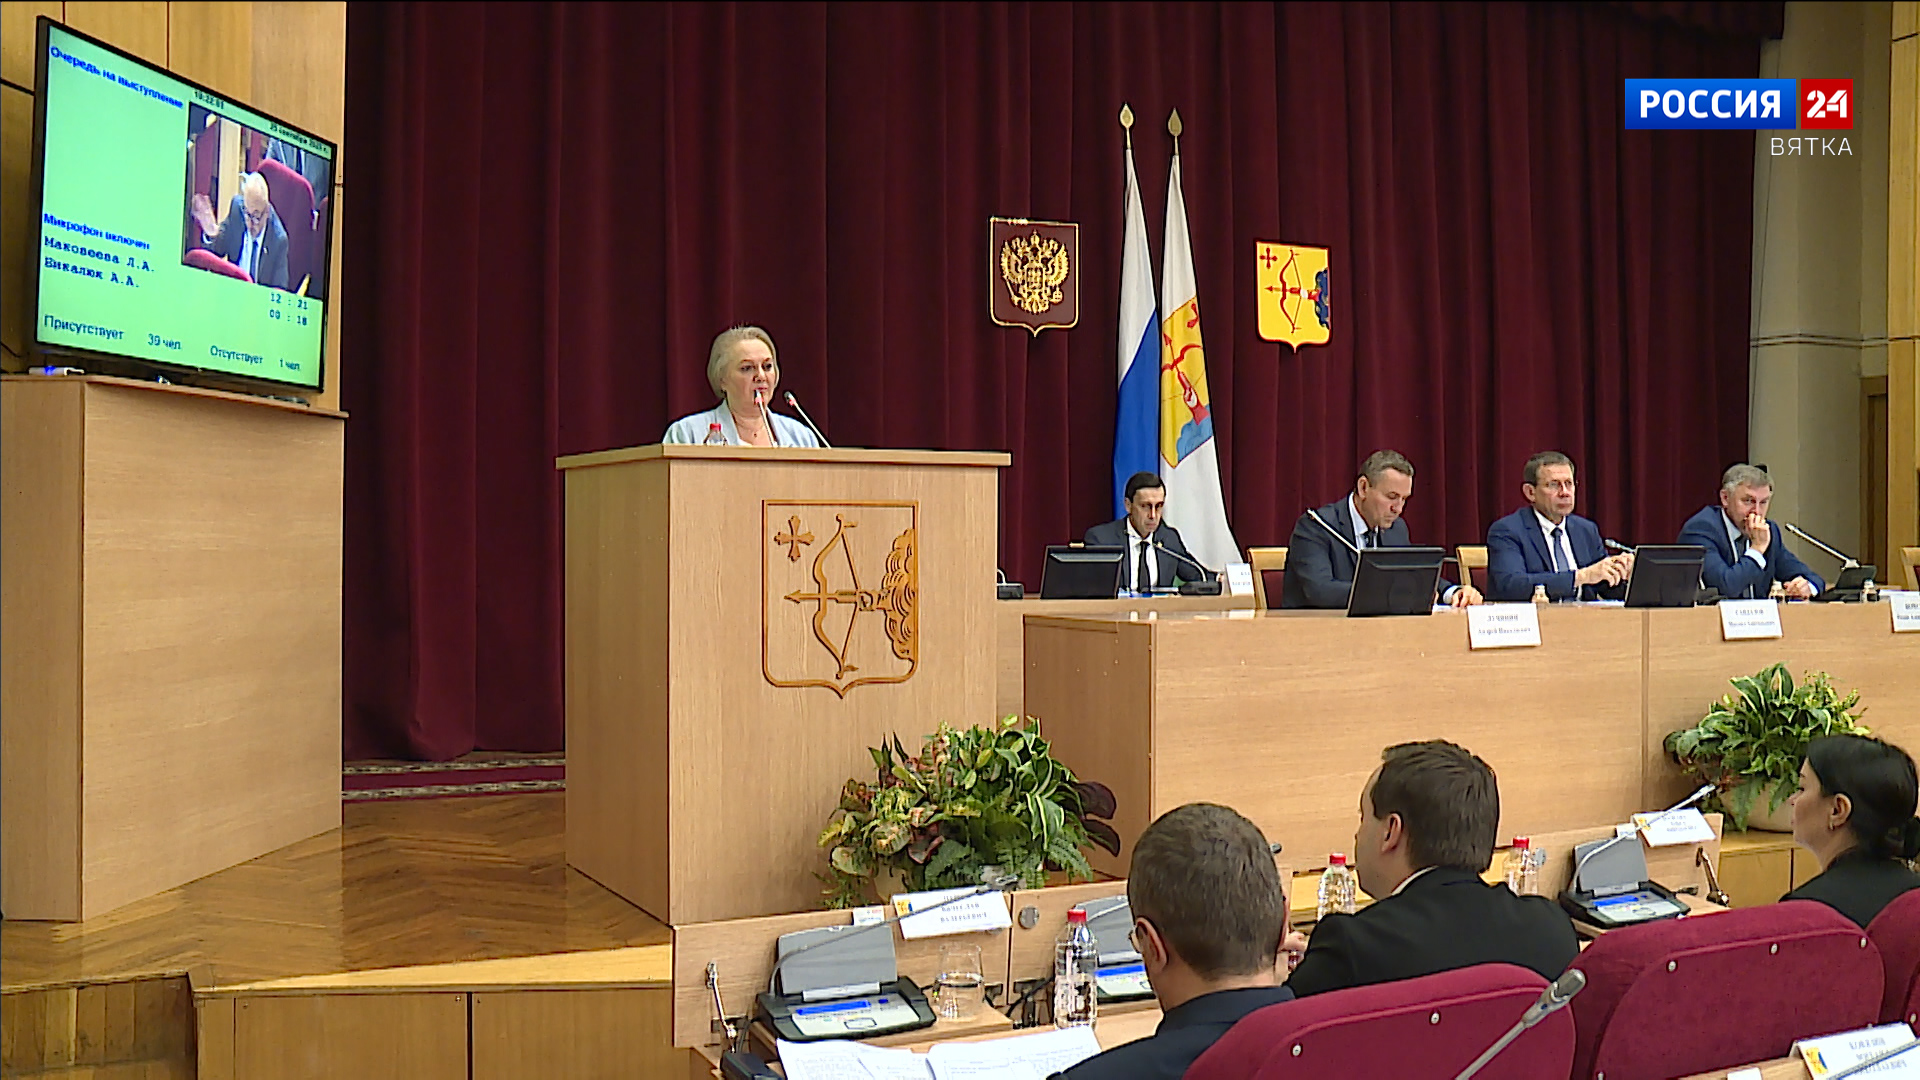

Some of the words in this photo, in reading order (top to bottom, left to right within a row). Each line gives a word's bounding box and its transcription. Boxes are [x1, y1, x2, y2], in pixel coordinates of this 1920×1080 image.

[50, 46, 101, 75] Очередь
[103, 69, 116, 82] на
[118, 76, 184, 108] выступление
[44, 213, 103, 238] Микрофон
[105, 231, 150, 250] включен
[44, 236, 120, 264] Маковеева
[127, 257, 154, 272] Л.А.
[44, 256, 104, 280] Викалюк
[110, 272, 140, 288] А.А.
[270, 292, 282, 304] 12
[297, 299, 308, 310] 21
[44, 314, 124, 340] Присутствует
[210, 345, 264, 365] Отсутствует
